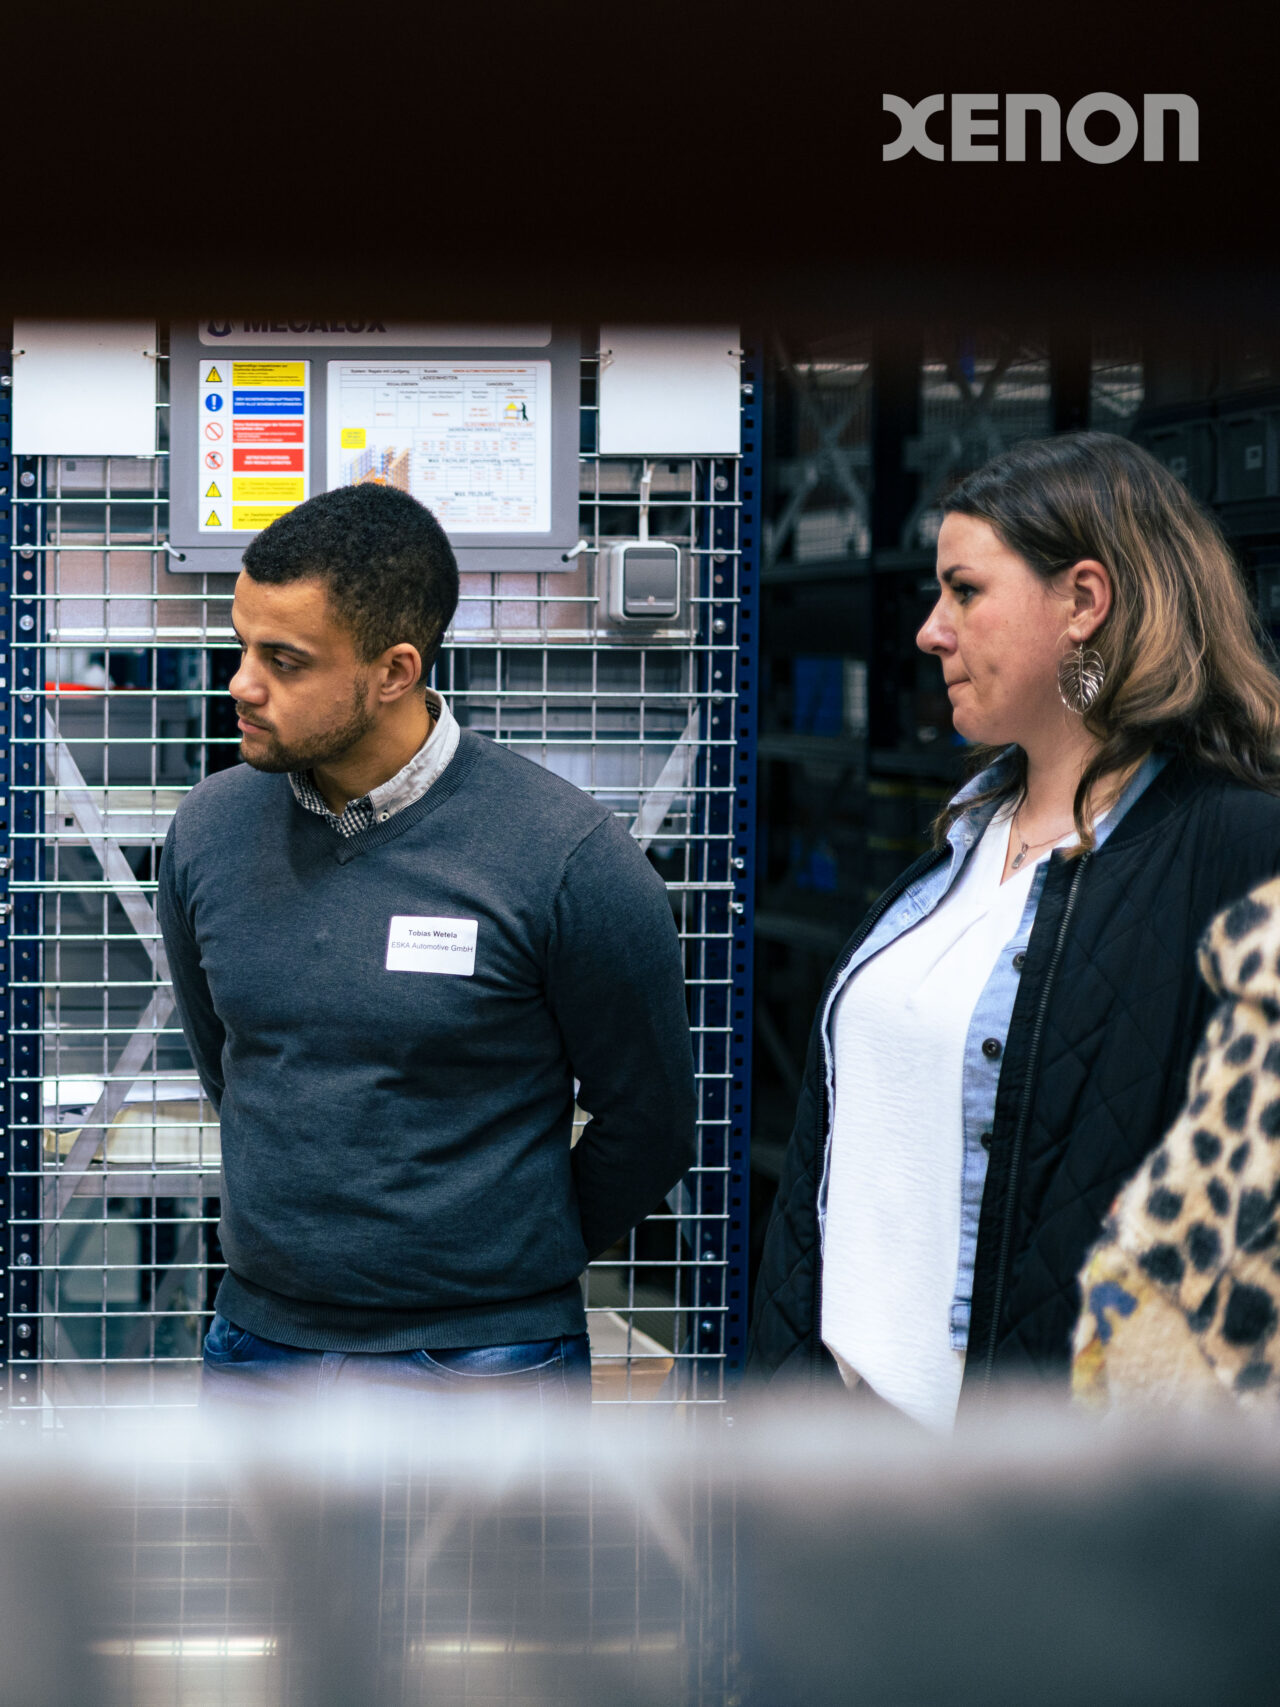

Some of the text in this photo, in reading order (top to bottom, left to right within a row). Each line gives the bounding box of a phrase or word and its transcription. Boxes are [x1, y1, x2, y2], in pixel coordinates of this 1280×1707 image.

[408, 929, 431, 937] Tobias
[391, 941, 474, 953] ESKA Automotive GmbH
